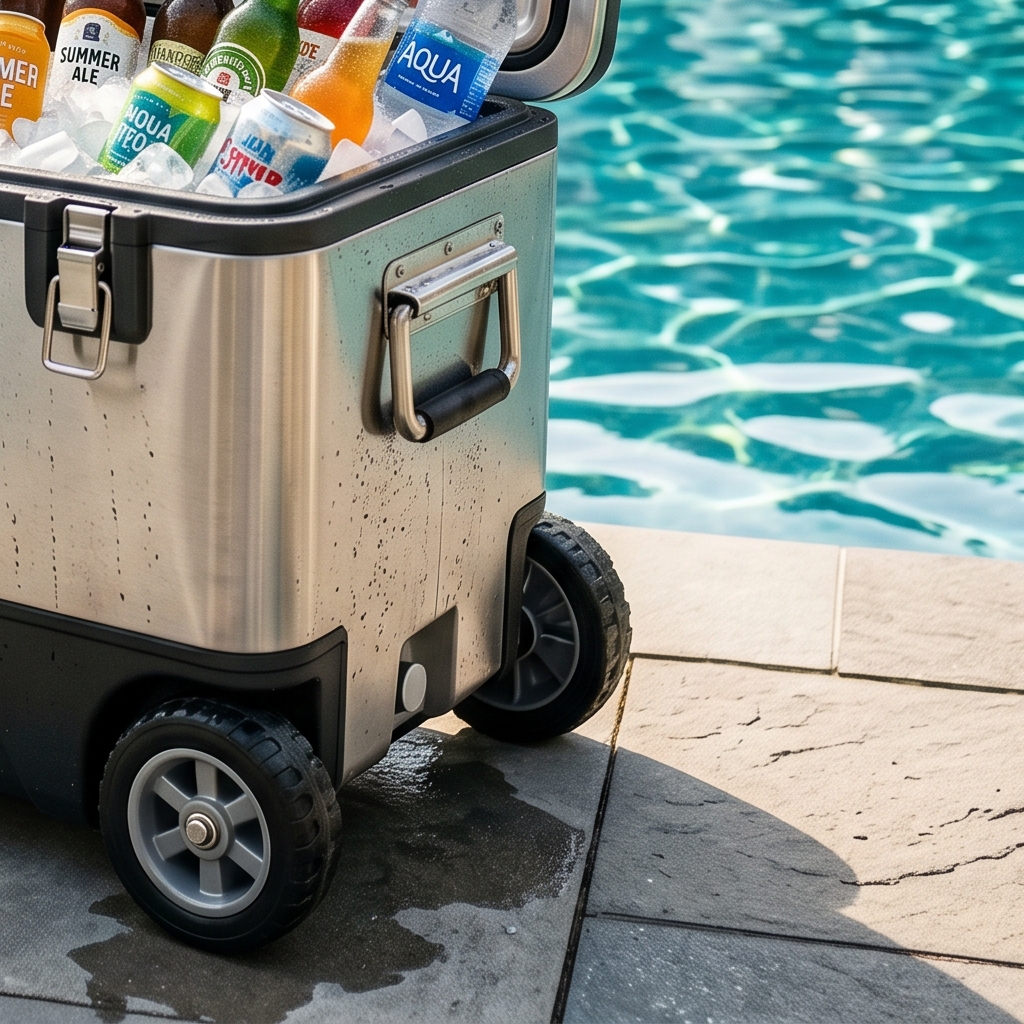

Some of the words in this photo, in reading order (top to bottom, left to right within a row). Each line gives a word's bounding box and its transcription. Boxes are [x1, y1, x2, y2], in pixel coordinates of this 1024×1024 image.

[60, 46, 120, 72] SUMMER
[397, 40, 462, 94] AQUA
[72, 66, 99, 85] ALE
